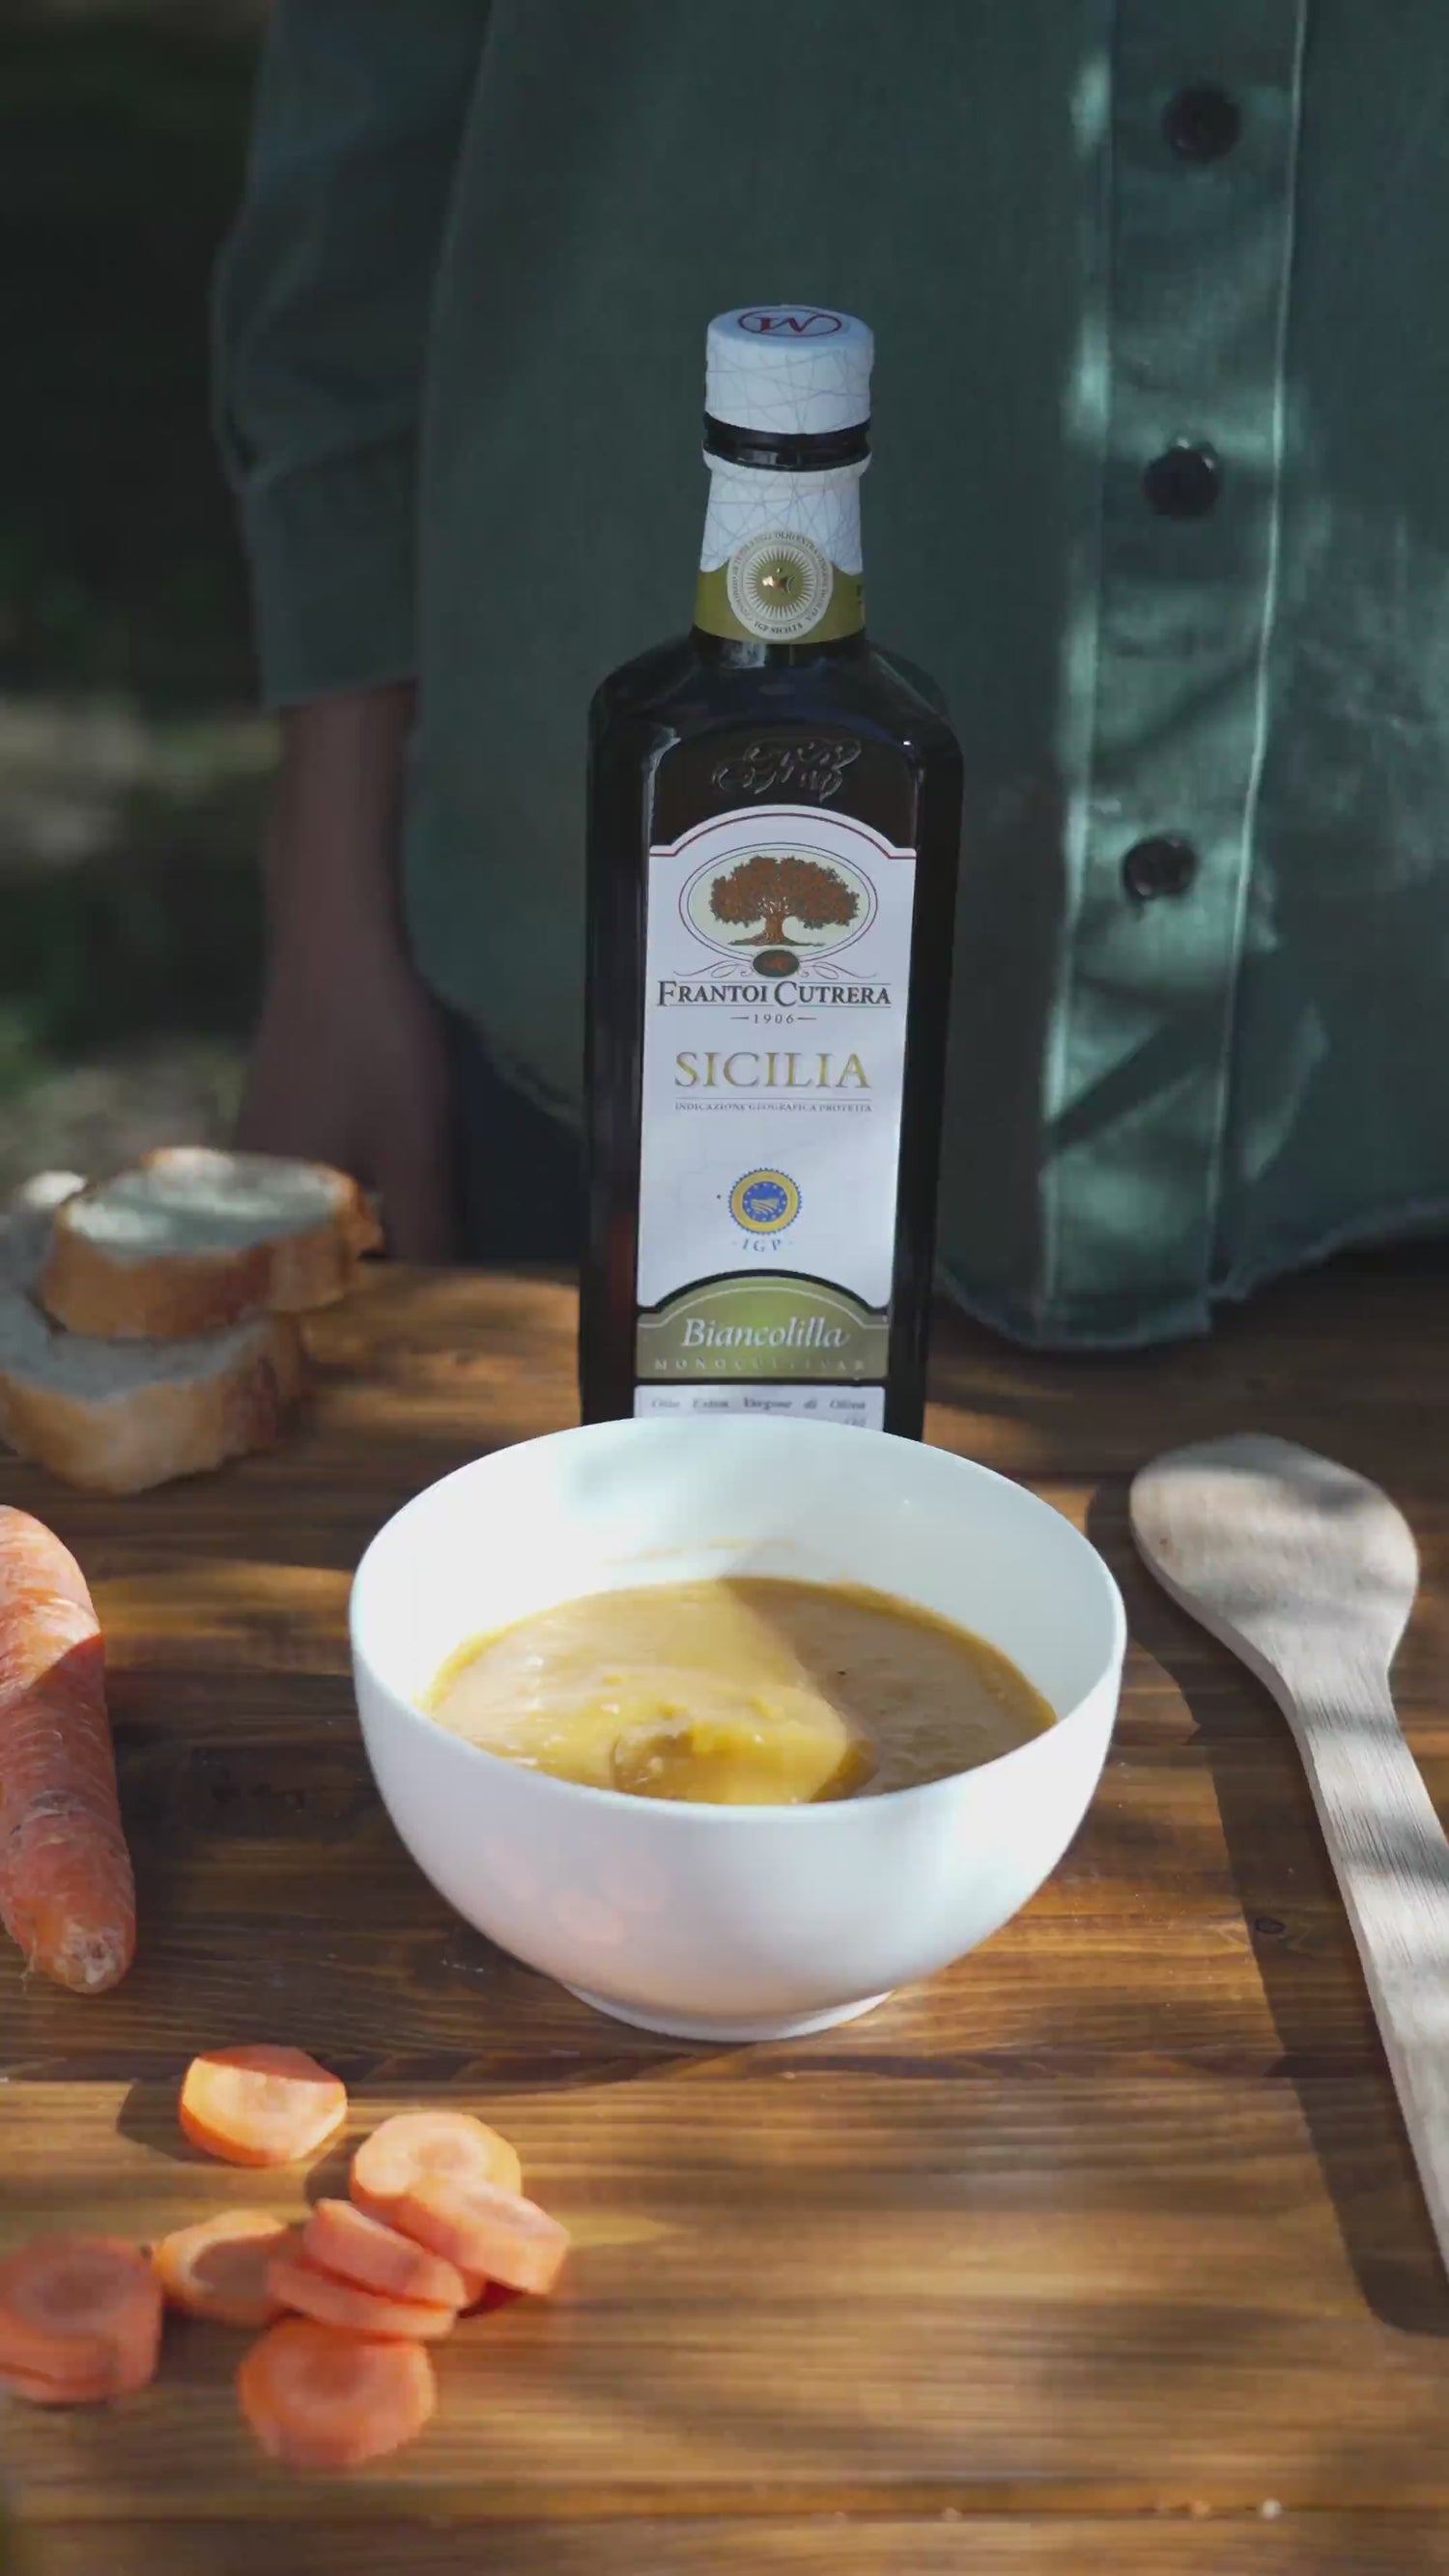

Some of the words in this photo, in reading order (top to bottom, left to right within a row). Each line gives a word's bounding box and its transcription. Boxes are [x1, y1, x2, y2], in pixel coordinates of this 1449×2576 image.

[657, 980, 768, 1006] FRANTOI
[774, 980, 892, 1006] CUTRERA
[753, 1014, 794, 1024] 1906
[674, 1051, 872, 1090] SICILIA
[675, 1103, 747, 1112] INDICAZIONE
[819, 1104, 872, 1113] PROTETTA
[681, 1316, 850, 1348] Biancolilla
[655, 1358, 866, 1372] MONOCULTIVAR
